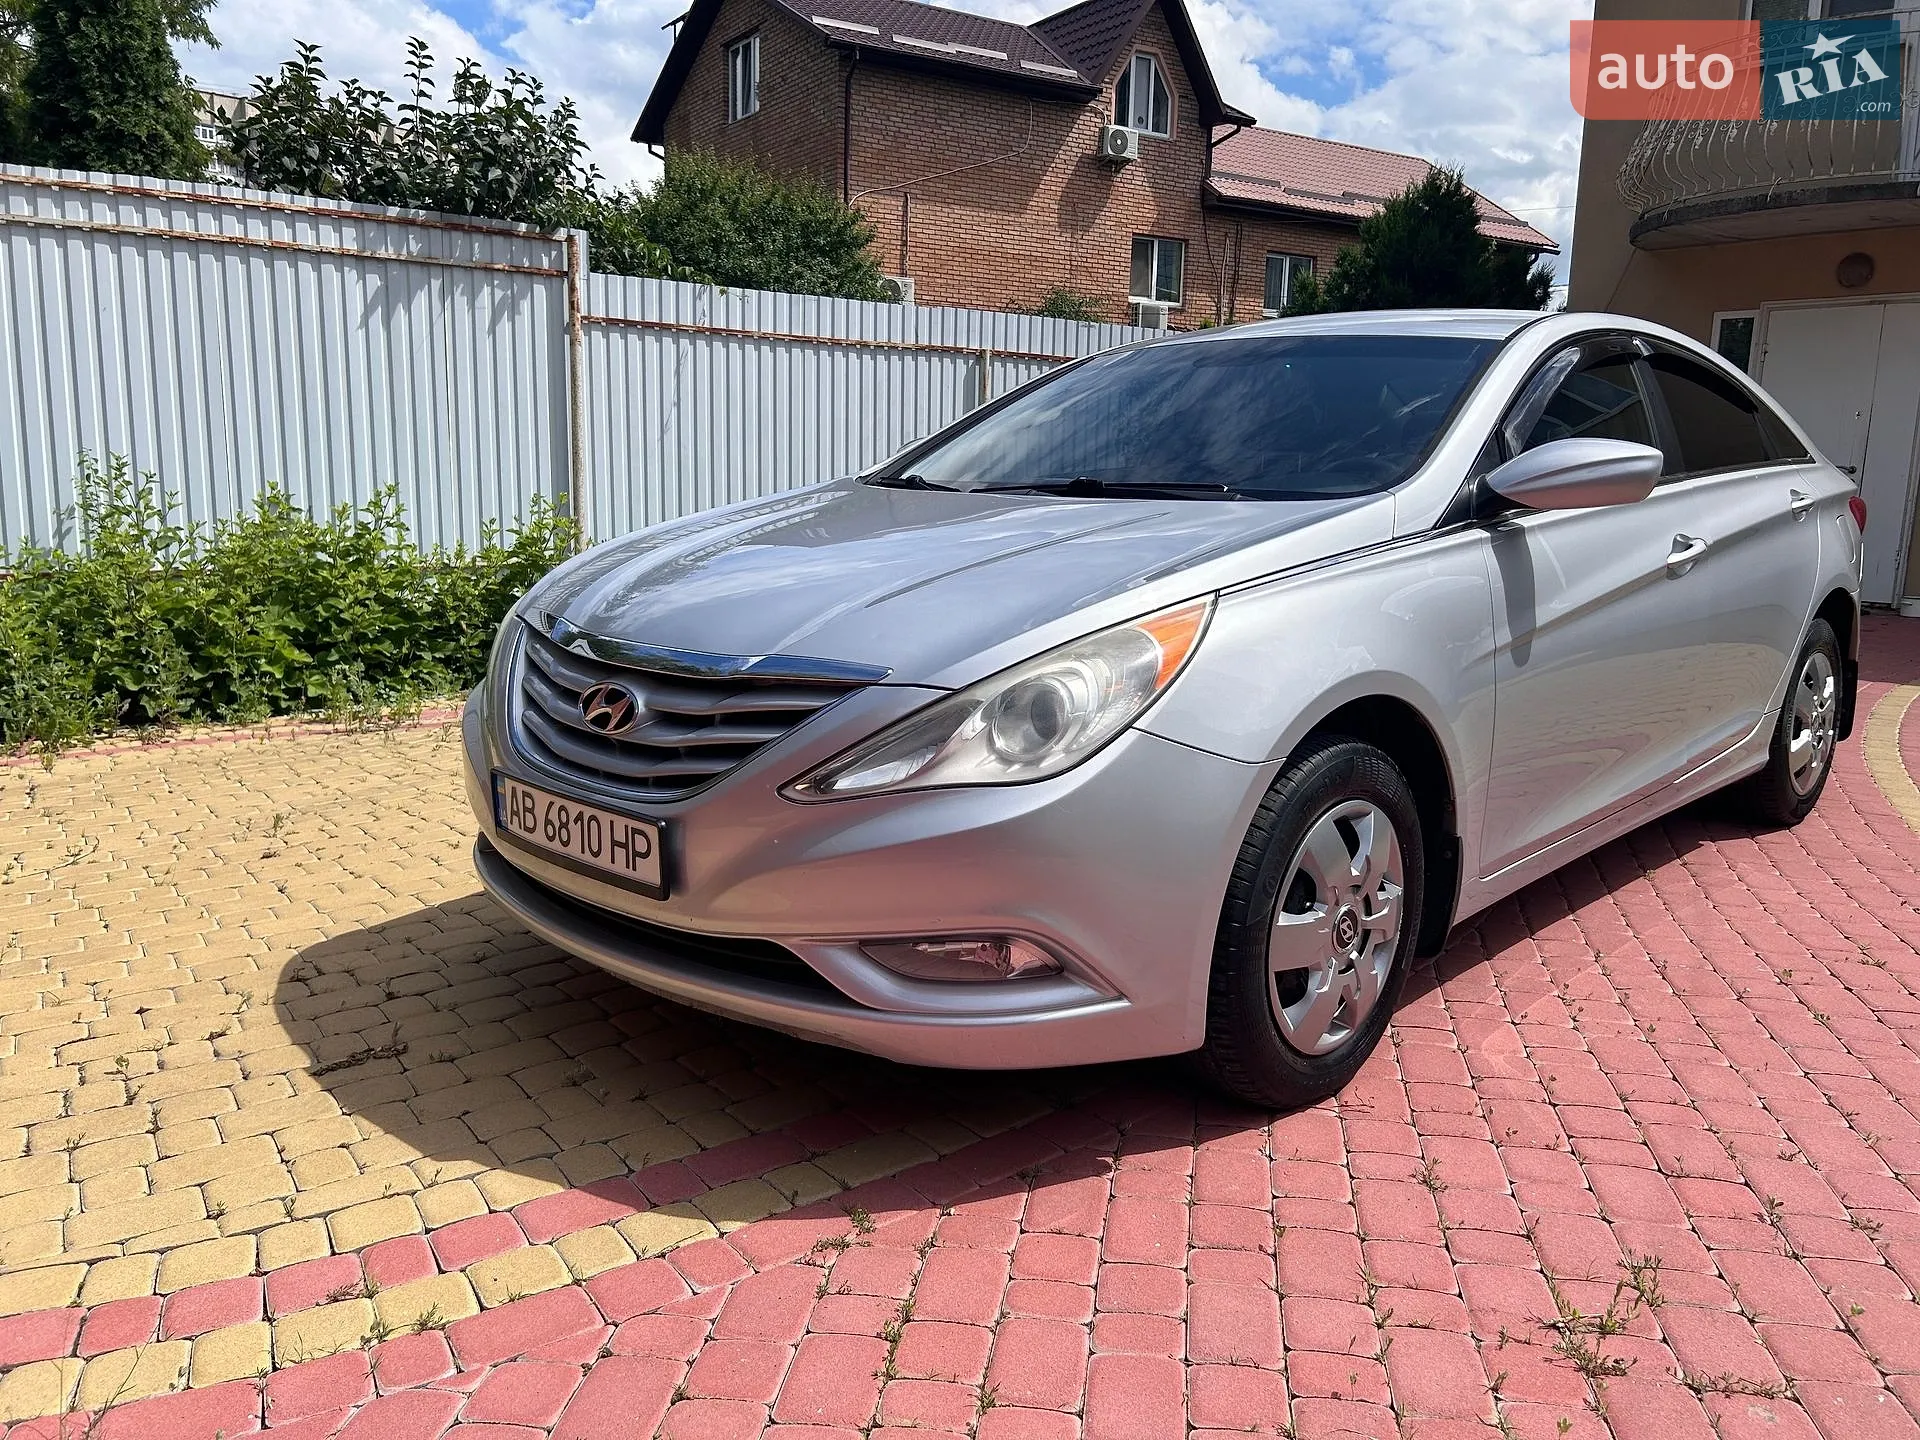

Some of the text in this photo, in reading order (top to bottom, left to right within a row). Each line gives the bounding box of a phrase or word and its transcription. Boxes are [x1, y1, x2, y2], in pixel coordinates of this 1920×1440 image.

[510, 786, 652, 871] AB 6810 HP
